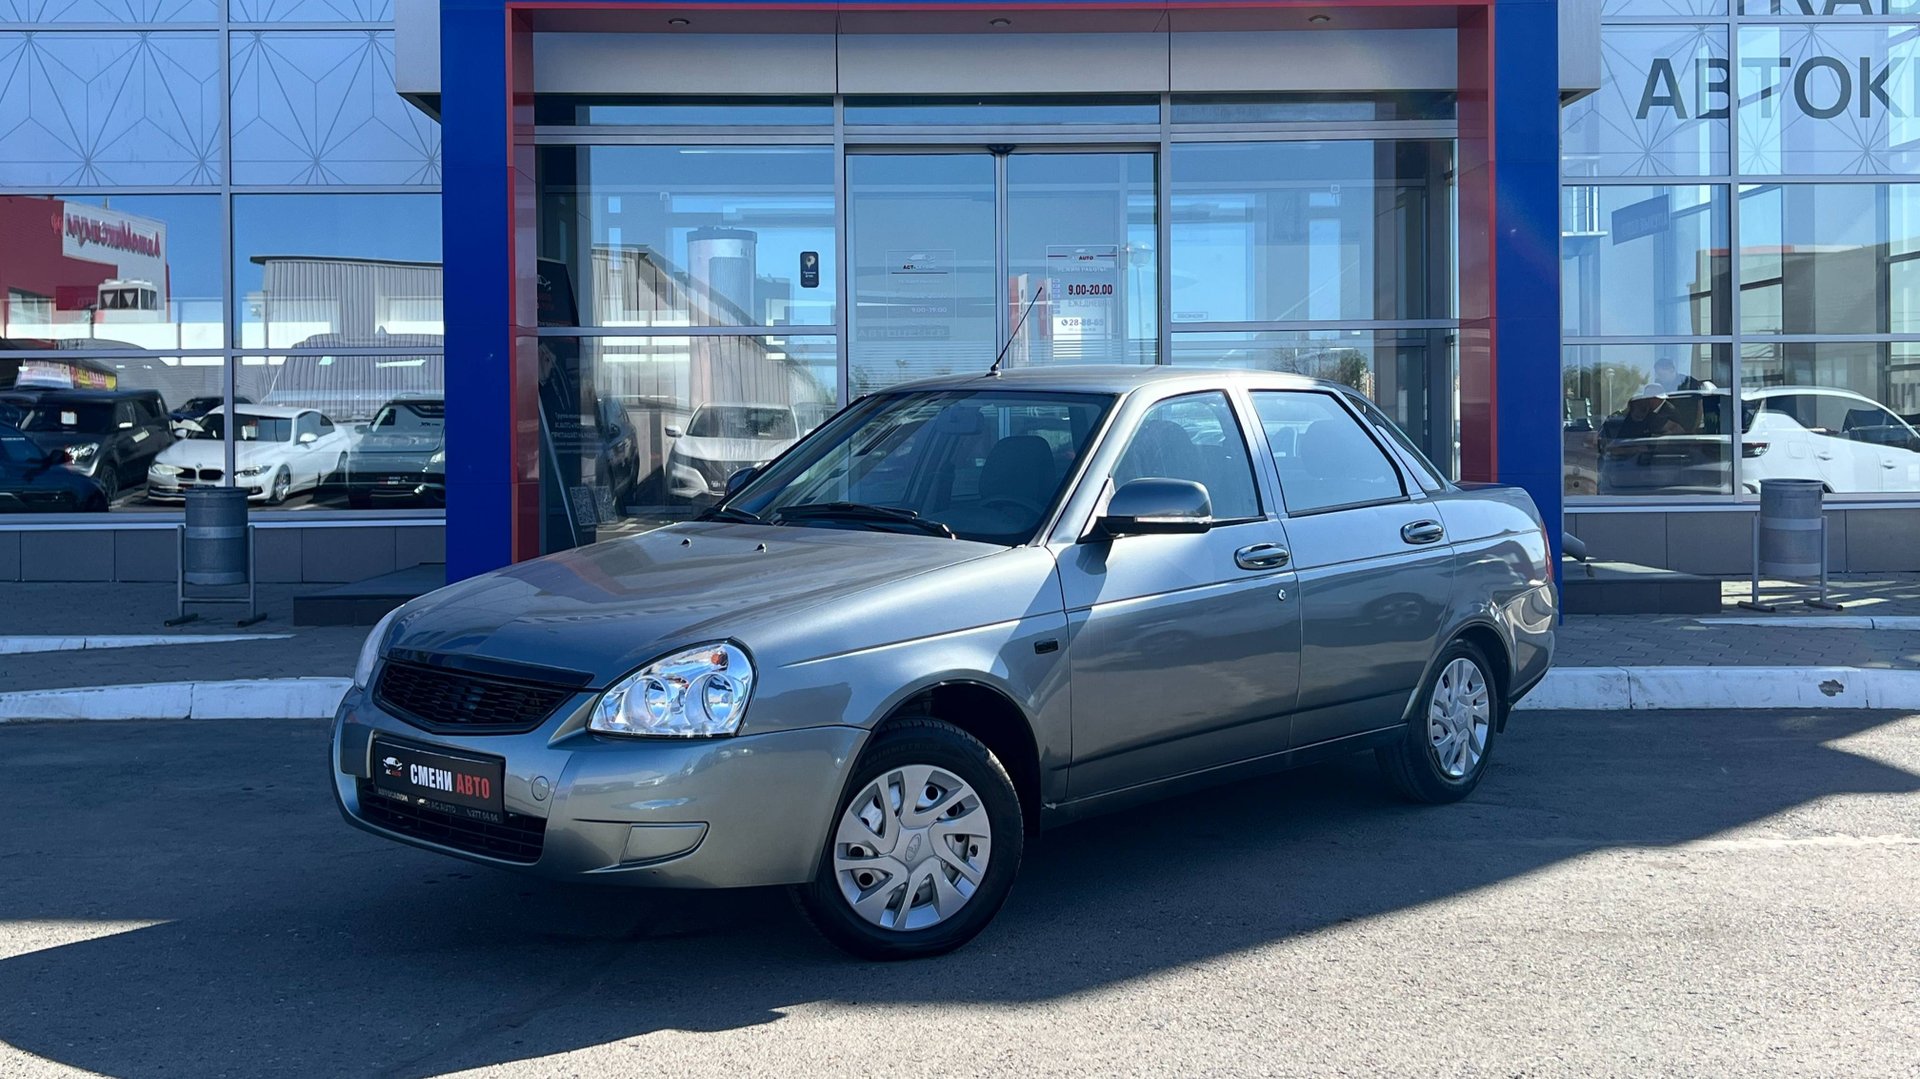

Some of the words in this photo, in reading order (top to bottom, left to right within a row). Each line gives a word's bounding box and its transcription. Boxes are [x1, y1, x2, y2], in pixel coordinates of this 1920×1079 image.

[1636, 57, 1920, 119] АВТОК
[1068, 284, 1113, 295] 9.00-20.00
[410, 763, 453, 792] СМЕНИ
[456, 771, 490, 799] АВТО
